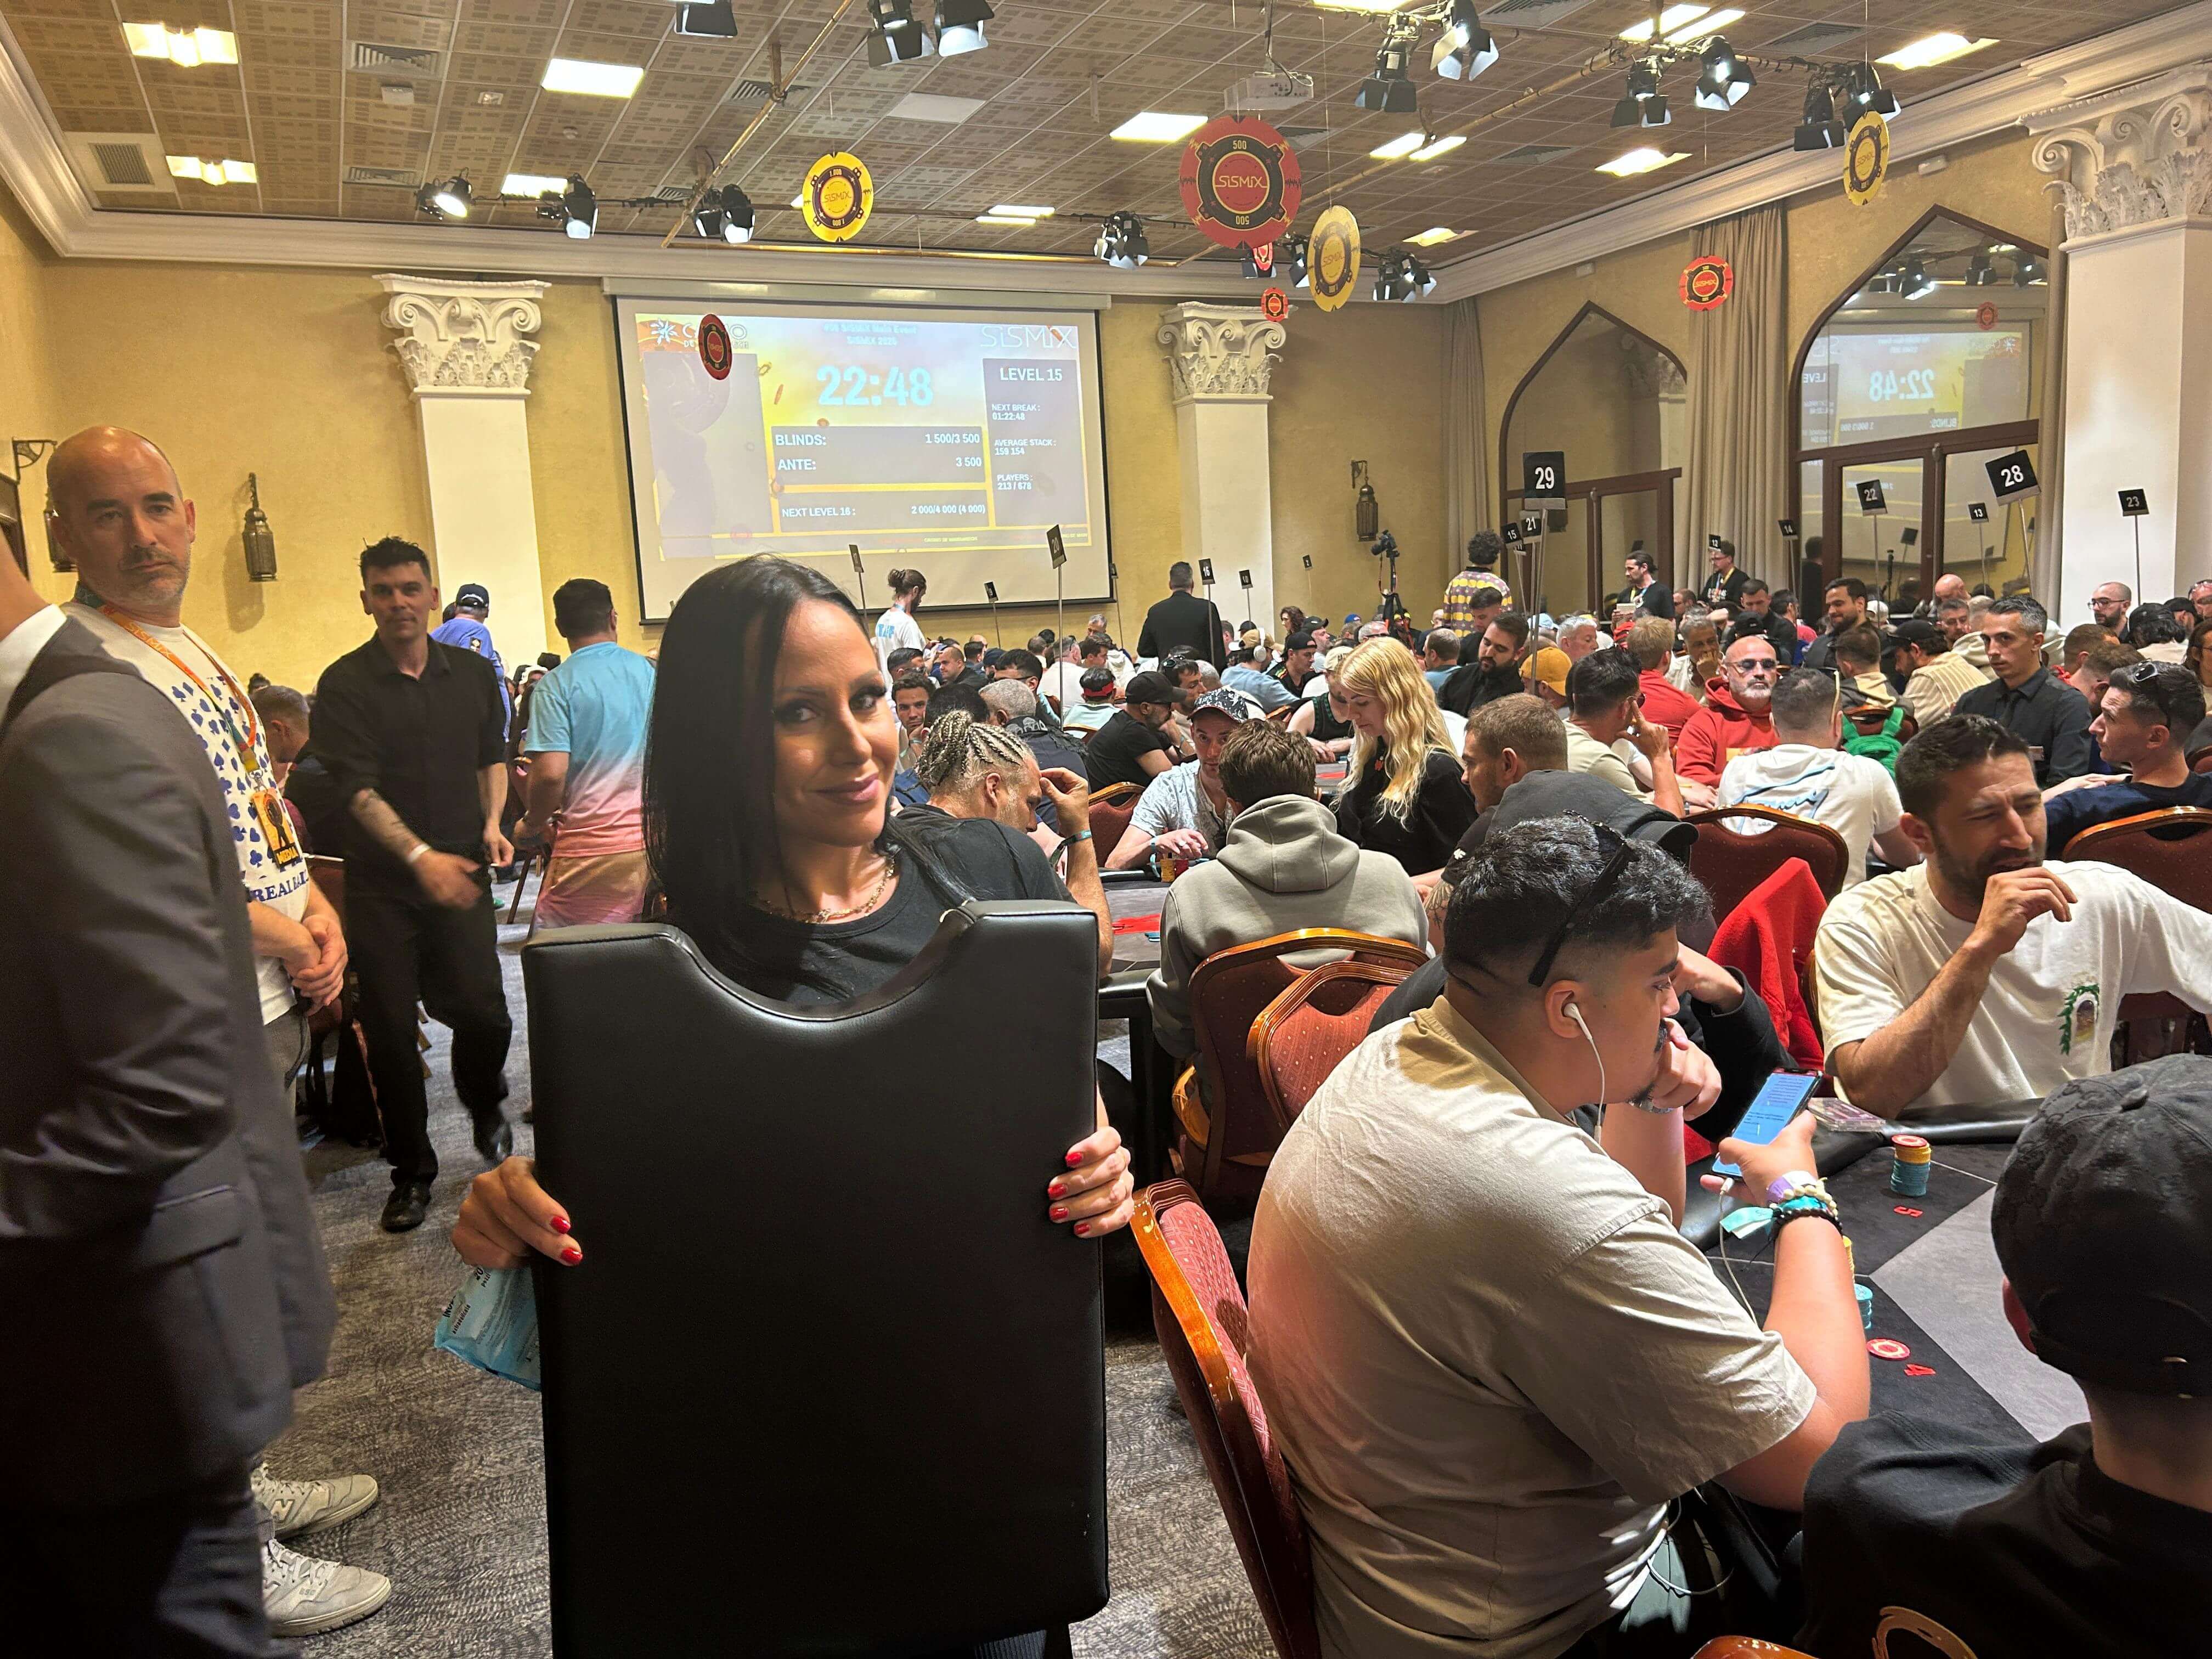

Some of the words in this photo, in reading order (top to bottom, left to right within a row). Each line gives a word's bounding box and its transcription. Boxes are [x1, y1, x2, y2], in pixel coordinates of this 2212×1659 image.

[1233, 140, 1247, 150] 500
[1235, 215, 1250, 225] 500
[1000, 368, 1045, 381] LEVEL
[1046, 369, 1063, 382] 15
[816, 365, 933, 406] 22:48
[992, 412, 1025, 420] 01:22:48
[775, 434, 827, 446] BLINDS:
[778, 459, 817, 470] ANTE:
[1535, 466, 1555, 489] 29
[2000, 465, 2024, 488] 28
[1863, 488, 1878, 502] 22
[2126, 496, 2140, 507] 23
[782, 508, 807, 517] NEXT
[809, 507, 839, 517] LEVEL
[1973, 506, 1984, 518] 13
[1526, 516, 1537, 532] 21
[1784, 524, 1793, 534] 14
[1508, 529, 1517, 540] 15
[1051, 537, 1060, 554] 20
[275, 846, 299, 865] MEDIA
[1893, 1206, 1923, 1217] 5
[1904, 1363, 1936, 1376] 4
